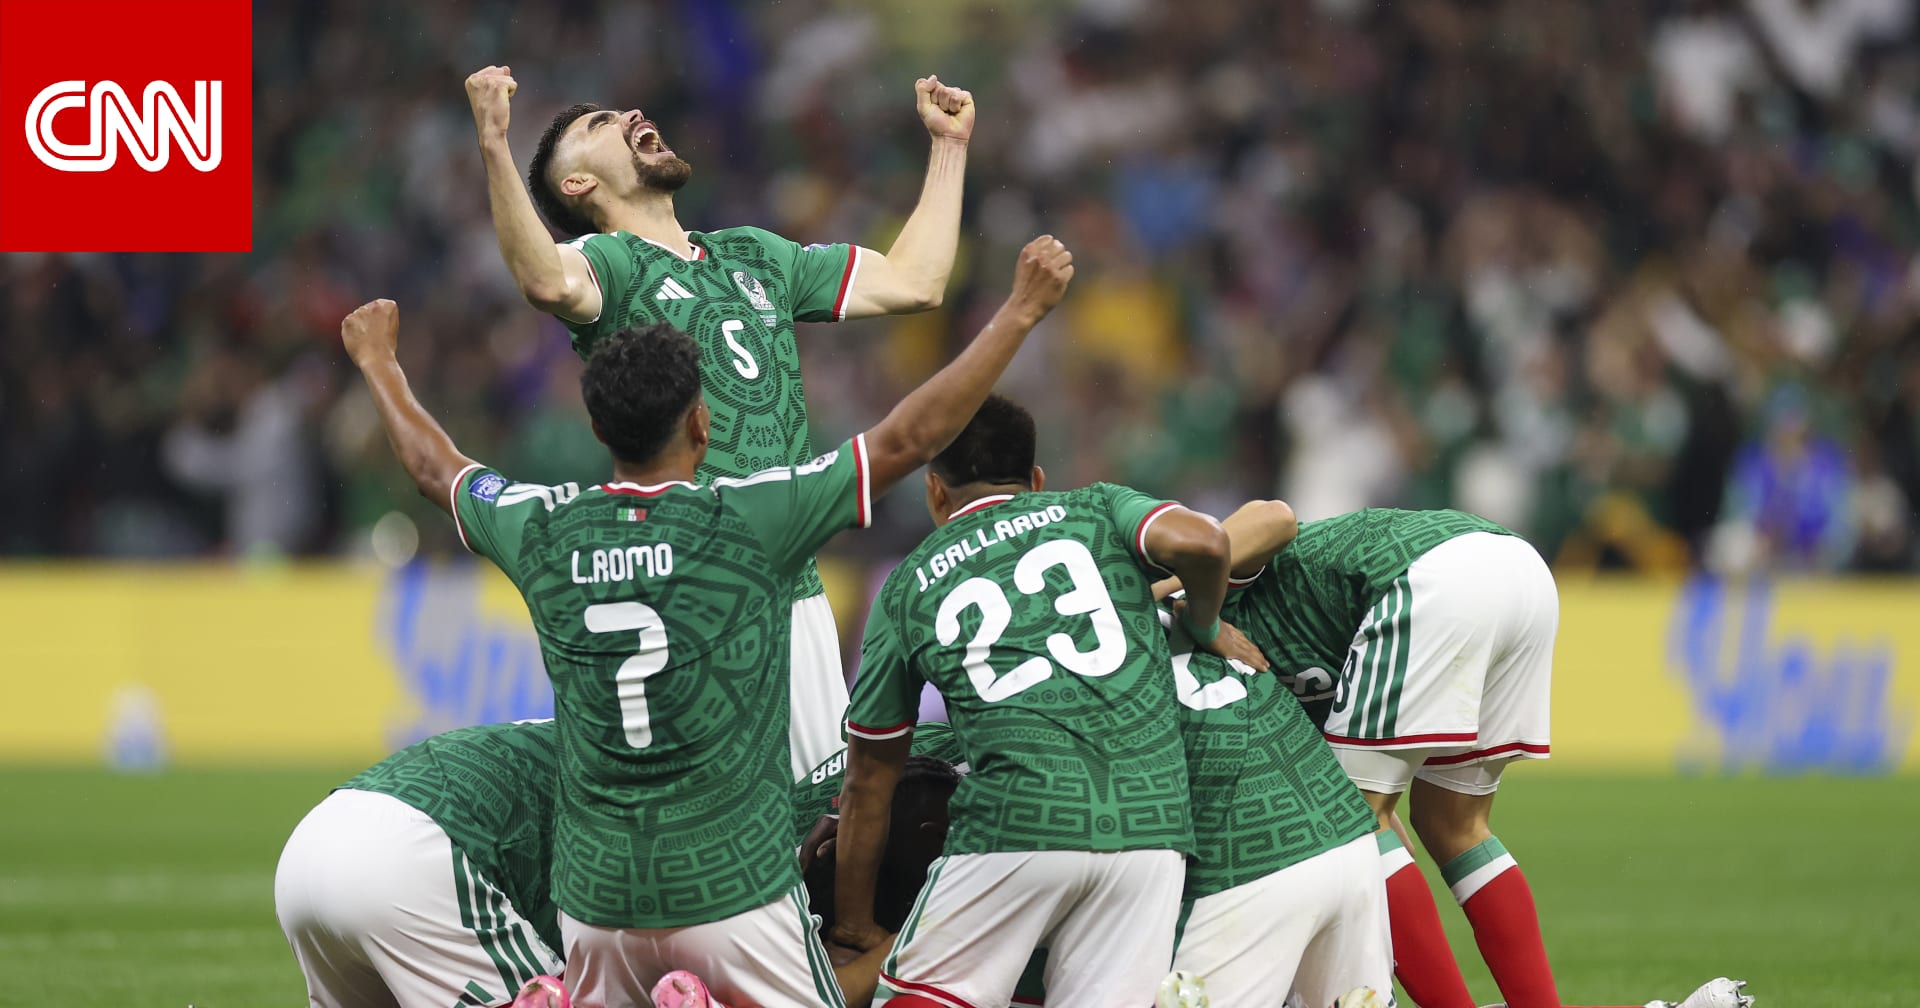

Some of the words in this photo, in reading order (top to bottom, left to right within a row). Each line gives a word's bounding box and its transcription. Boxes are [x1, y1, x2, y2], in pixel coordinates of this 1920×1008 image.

[721, 319, 760, 380] 5
[571, 542, 673, 584] L.ROMO
[915, 505, 1067, 593] J.GALLARDO
[935, 538, 1128, 703] 23
[584, 601, 670, 749] 7
